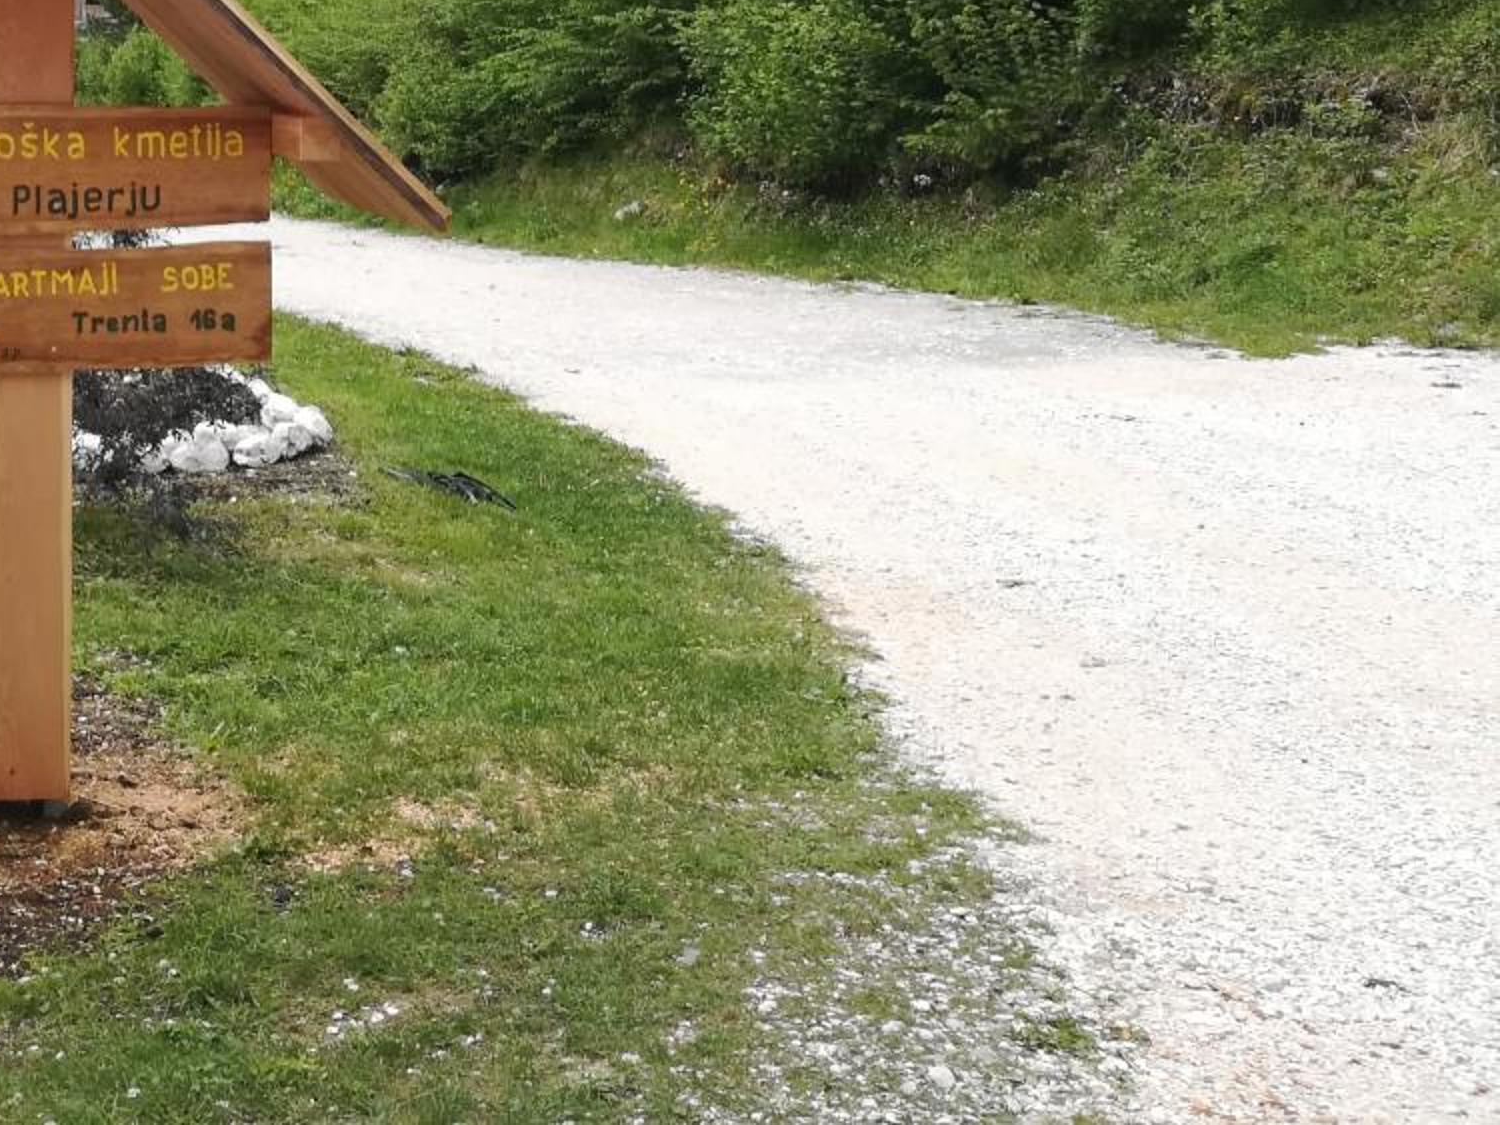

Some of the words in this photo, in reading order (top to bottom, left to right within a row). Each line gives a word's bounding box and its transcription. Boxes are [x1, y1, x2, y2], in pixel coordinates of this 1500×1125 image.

[113, 122, 244, 161] kmetija
[12, 180, 161, 219] Plajerju
[160, 262, 234, 293] SOBE
[72, 309, 167, 335] Trenta
[189, 308, 236, 332] 16a
